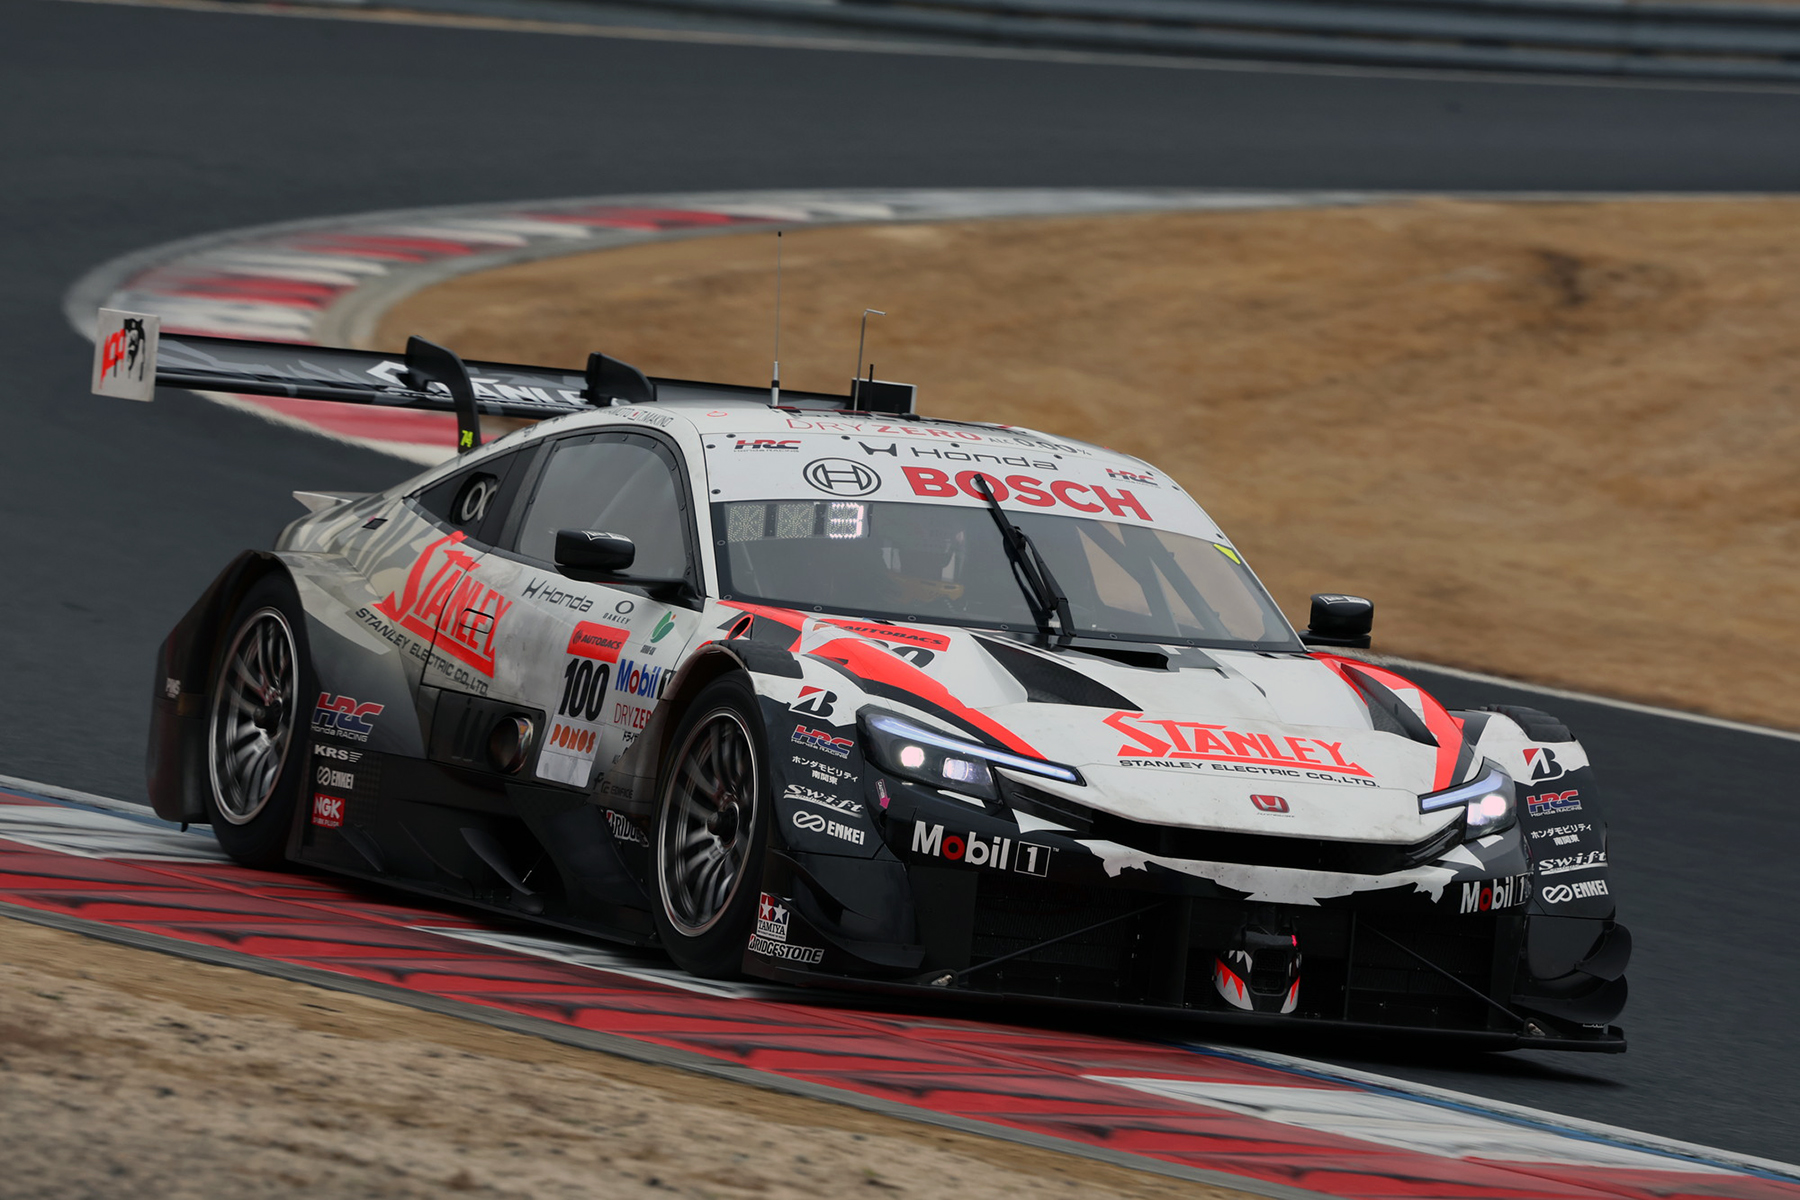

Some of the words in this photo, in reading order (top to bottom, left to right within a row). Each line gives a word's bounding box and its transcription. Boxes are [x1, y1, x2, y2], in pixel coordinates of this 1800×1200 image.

[735, 439, 802, 450] HRC
[911, 447, 1058, 470] Honda
[901, 466, 1154, 521] BOSCH
[372, 530, 513, 658] STANLEY
[538, 585, 594, 613] Honda
[603, 612, 631, 625] OAKLEY
[355, 607, 411, 650] STANLEY
[409, 643, 454, 682] ELECTRIC
[580, 634, 623, 650] AUTOBACS
[843, 625, 944, 645] AUTOBACS
[558, 658, 610, 721] 100
[615, 658, 662, 698] Mobil
[311, 691, 385, 736] HRC
[311, 724, 336, 737] Honda
[336, 729, 369, 743] RACING
[549, 723, 597, 754] PONOS
[791, 725, 855, 756] HRC
[1102, 711, 1358, 767] STANLEY
[314, 744, 349, 761] KRS
[331, 770, 354, 789] ENKEI
[792, 755, 859, 783] ホンダモビリティ
[1120, 759, 1204, 770] STANLEY
[1212, 763, 1300, 778] ELECTRIC
[314, 796, 342, 819] NGK
[1526, 789, 1581, 813] HRC
[826, 821, 865, 846] ENKEI
[1531, 823, 1592, 839] ホンダモビリティ
[912, 820, 1011, 870] Mobil
[1460, 875, 1514, 914] Mobil
[1571, 880, 1609, 899] ENKEI
[758, 920, 786, 936] TAMIYA
[748, 933, 824, 964] BRIDGESTONE
